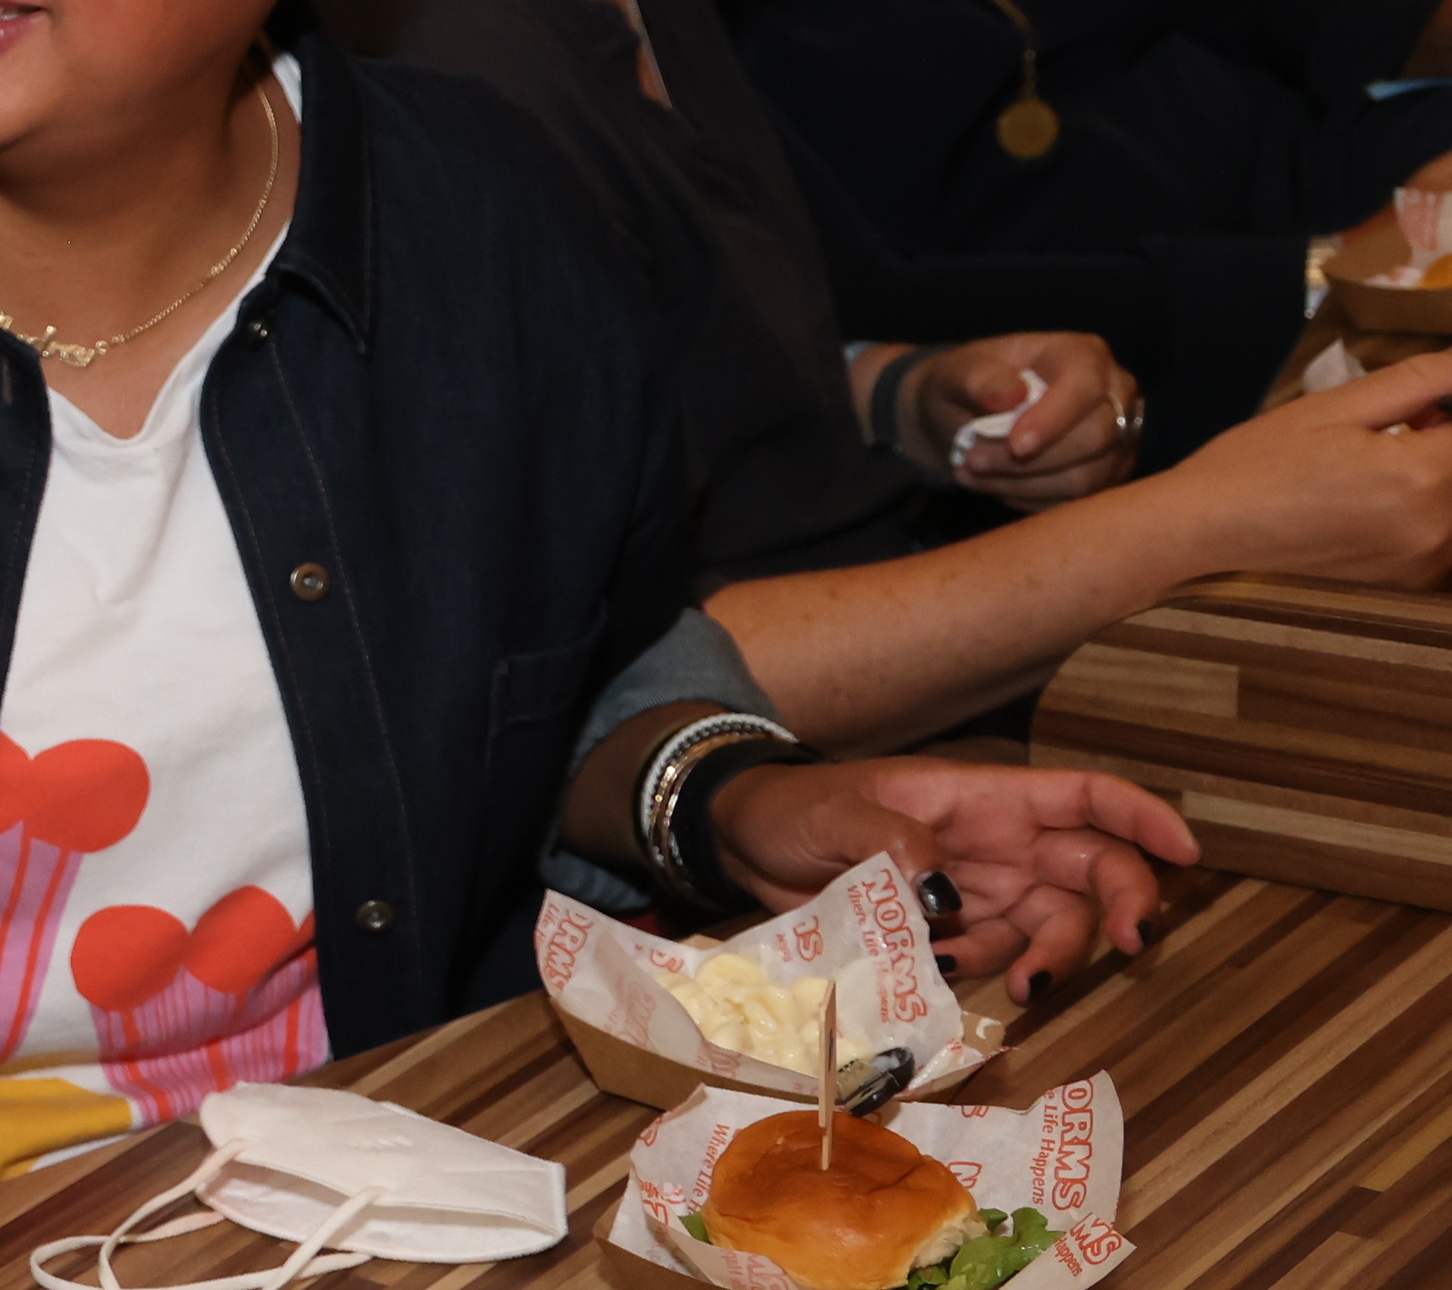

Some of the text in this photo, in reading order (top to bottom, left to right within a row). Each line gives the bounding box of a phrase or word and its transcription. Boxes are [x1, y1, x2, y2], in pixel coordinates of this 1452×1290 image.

[693, 1123, 730, 1198] Where Life
[1030, 1104, 1058, 1205] Life Happens
[1052, 1079, 1093, 1211] ORMS
